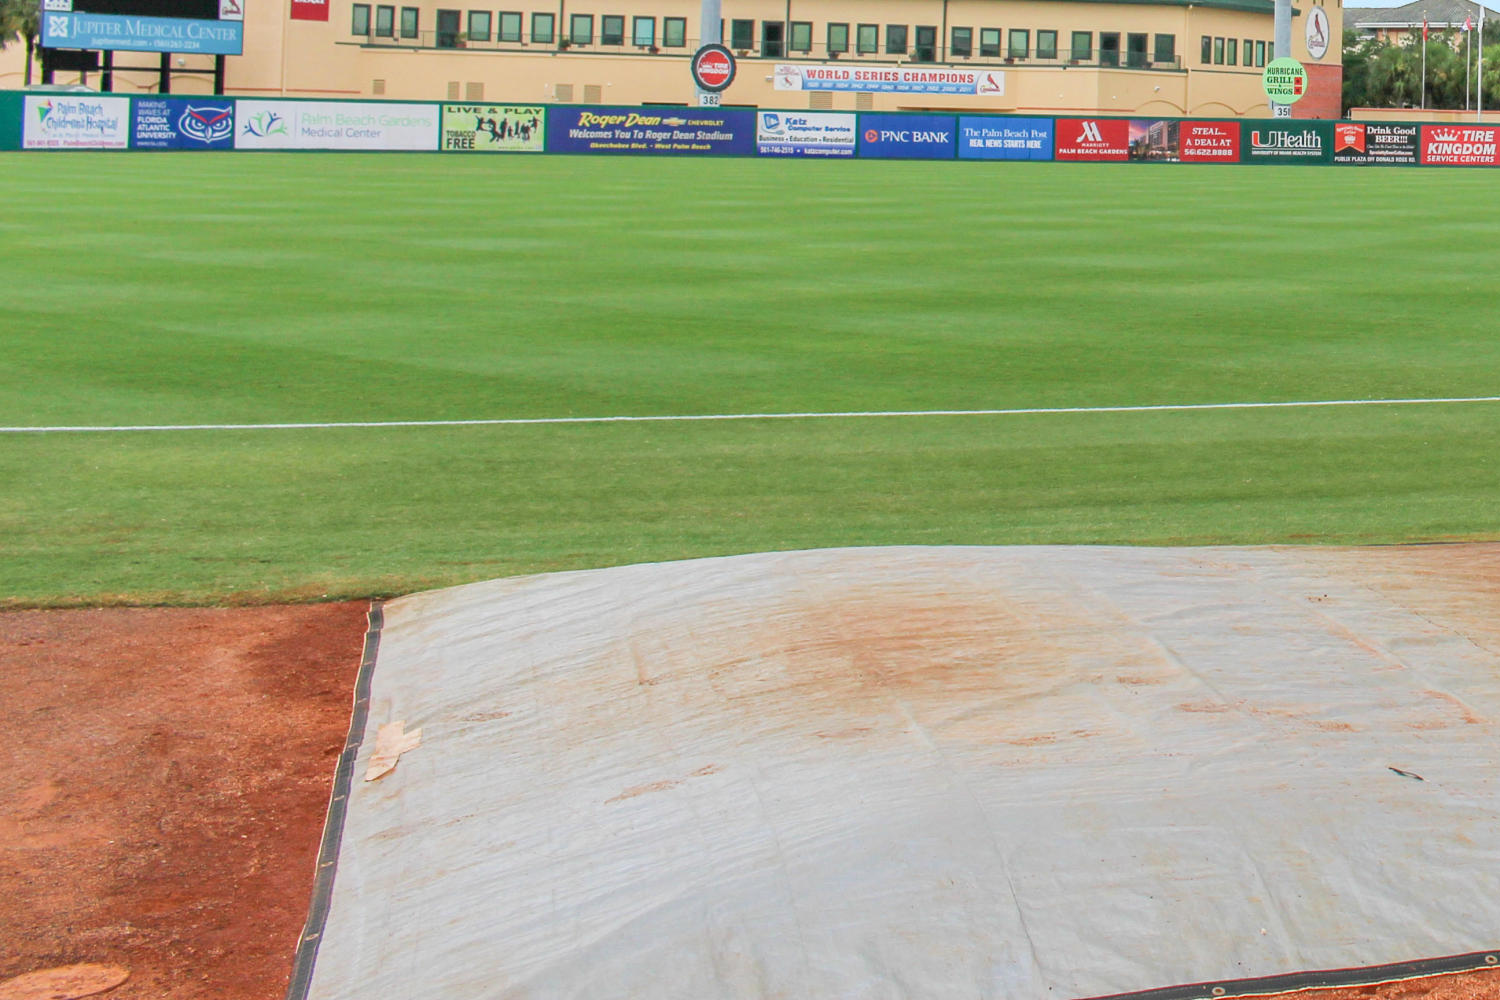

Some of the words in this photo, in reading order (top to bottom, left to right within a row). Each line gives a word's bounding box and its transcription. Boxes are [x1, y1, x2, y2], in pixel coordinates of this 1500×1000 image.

[71, 17, 121, 38] JUPITER
[125, 19, 183, 38] MEDICAL
[187, 22, 237, 41] CENTER
[807, 69, 849, 80] WORLD
[855, 71, 899, 81] SERIES
[904, 72, 974, 84] CHAMPIONS
[1267, 67, 1303, 76] HURRICANE
[1267, 76, 1293, 84] GRILL
[703, 96, 719, 105] 382
[57, 102, 76, 114] Palm
[79, 102, 103, 115] Beach
[138, 108, 161, 116] WAVES
[86, 116, 118, 132] Hospital
[302, 112, 333, 125] Palm
[336, 113, 376, 126] Beach
[379, 115, 433, 127] Gardens
[578, 112, 626, 128] Roger
[624, 113, 661, 127] Dean
[785, 117, 807, 126] Katz
[301, 127, 343, 137] Medical
[345, 127, 382, 138] Center
[446, 130, 476, 138] TOBACCO
[569, 129, 612, 139] Welcomes
[614, 129, 632, 139] You
[633, 129, 644, 139] To
[645, 130, 671, 141] Roger
[672, 130, 694, 140] Dean
[696, 131, 733, 141] Stadium
[963, 127, 981, 137] The
[982, 128, 1002, 138] Palm
[1004, 128, 1028, 138] Beach
[1031, 129, 1047, 138] Post
[1367, 126, 1391, 135] Drink
[1393, 127, 1416, 135] Good
[1462, 130, 1495, 142] TIRE
[881, 130, 910, 142] PNC
[912, 131, 949, 144] BANK
[1186, 138, 1192, 146] A
[1194, 138, 1218, 146] DEAL
[1220, 139, 1232, 147] AT
[1375, 135, 1408, 143] BEER!!!
[446, 138, 475, 149] FREE
[969, 139, 985, 148] REAL
[986, 139, 1002, 148] NEWS
[1003, 139, 1025, 148] STARTS
[1026, 140, 1042, 149] HERE
[1427, 143, 1496, 155] KINGDOM
[1460, 155, 1495, 163] CENTERS
